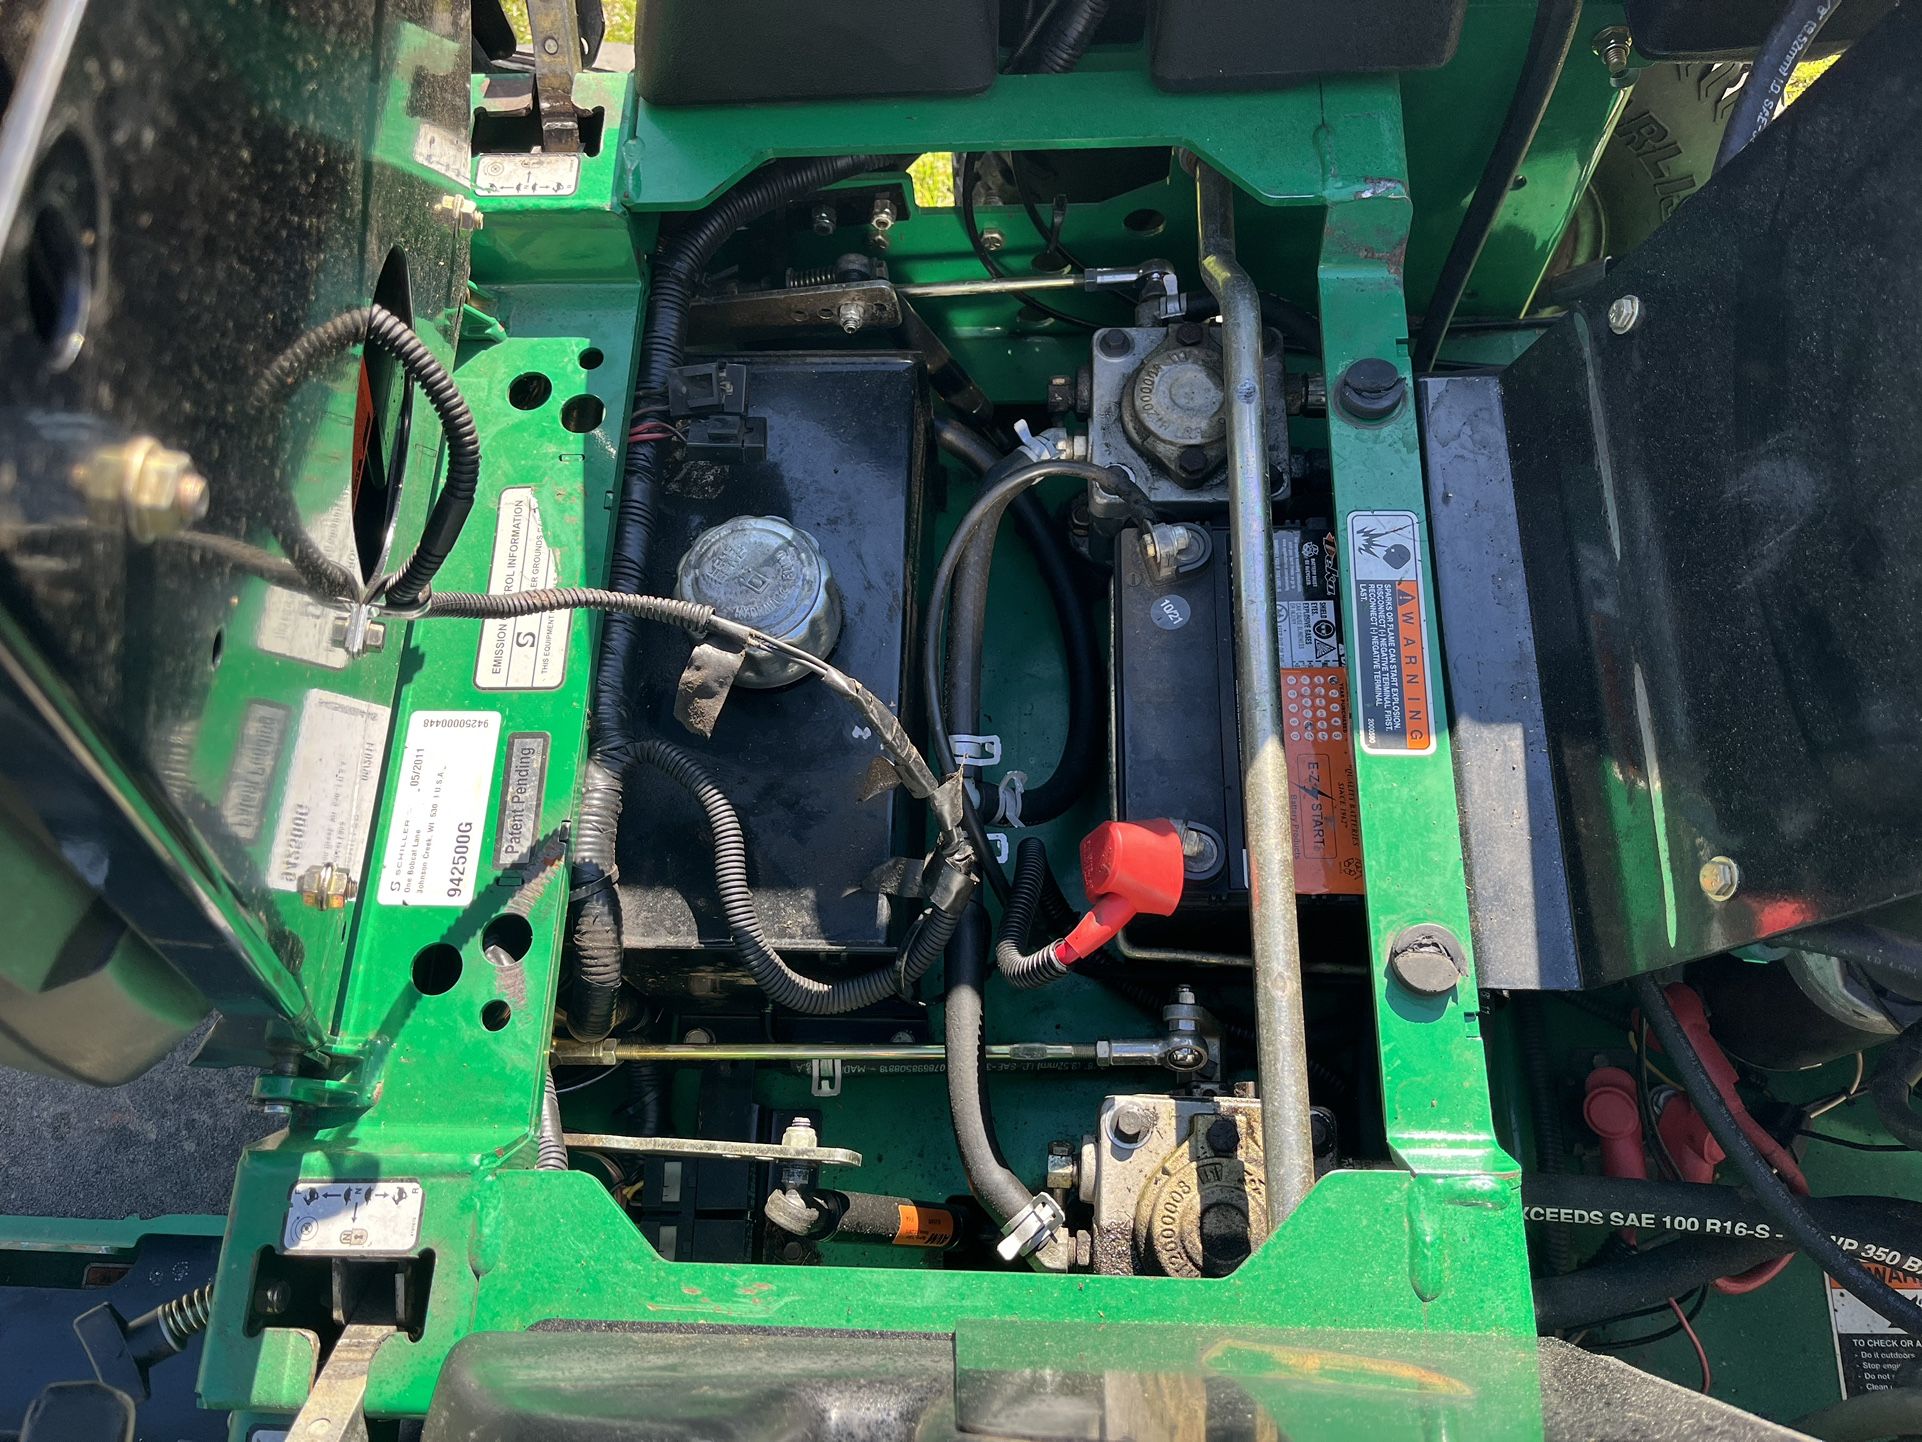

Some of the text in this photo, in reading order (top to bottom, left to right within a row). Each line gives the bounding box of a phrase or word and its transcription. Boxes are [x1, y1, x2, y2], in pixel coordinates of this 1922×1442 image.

[531, 535, 543, 575] GROUNDS
[1323, 533, 1339, 595] Deka
[492, 624, 507, 674] EMISSION
[508, 500, 523, 568] INFORMATION
[1359, 584, 1367, 602] LAST.
[1369, 584, 1378, 626] RECONNECT
[1376, 584, 1387, 628] DISCONNECT
[1159, 598, 1184, 625] 10/21
[1303, 602, 1313, 645] EXPLOSIVE GASES
[1319, 602, 1328, 619] SHIELD
[541, 616, 555, 675] THIS EQUIPMENT
[1372, 637, 1382, 669] NEGATIVE
[1380, 638, 1389, 672] NEGATIVE
[1384, 584, 1401, 730] SPARKS OR FLAME CAN START EXPLOSION.
[1374, 671, 1384, 707] TERMINAL
[1382, 673, 1392, 709] TERMINAL
[1401, 612, 1423, 740] WARNING
[423, 718, 489, 728] 94250000448
[1340, 700, 1348, 734] PURCHASED
[1384, 711, 1394, 732] FIRST.
[410, 748, 424, 787] 05/2011
[505, 748, 535, 855] Patent Pending
[1290, 795, 1301, 860] Battery Products
[1348, 804, 1360, 847] BATTERIES
[395, 819, 409, 876] SCHILLER
[404, 829, 421, 893] One Bobcat Lane
[447, 822, 473, 898] 942500G
[417, 862, 428, 894] Johnson
[1523, 1206, 1604, 1225] XCEEDS
[1609, 1211, 1656, 1228] SAE
[1662, 1216, 1699, 1232] 100
[1705, 1218, 1771, 1239] R16-S
[1861, 1244, 1901, 1265] 350
[1852, 1339, 1865, 1347] TO
[1866, 1339, 1899, 1347] CHECK
[1900, 1339, 1913, 1347] OR
[1861, 1351, 1916, 1359] Do it outdoors
[1862, 1362, 1881, 1371] Stop
[1877, 1372, 1890, 1380] not
[1865, 1383, 1889, 1391] Clean
